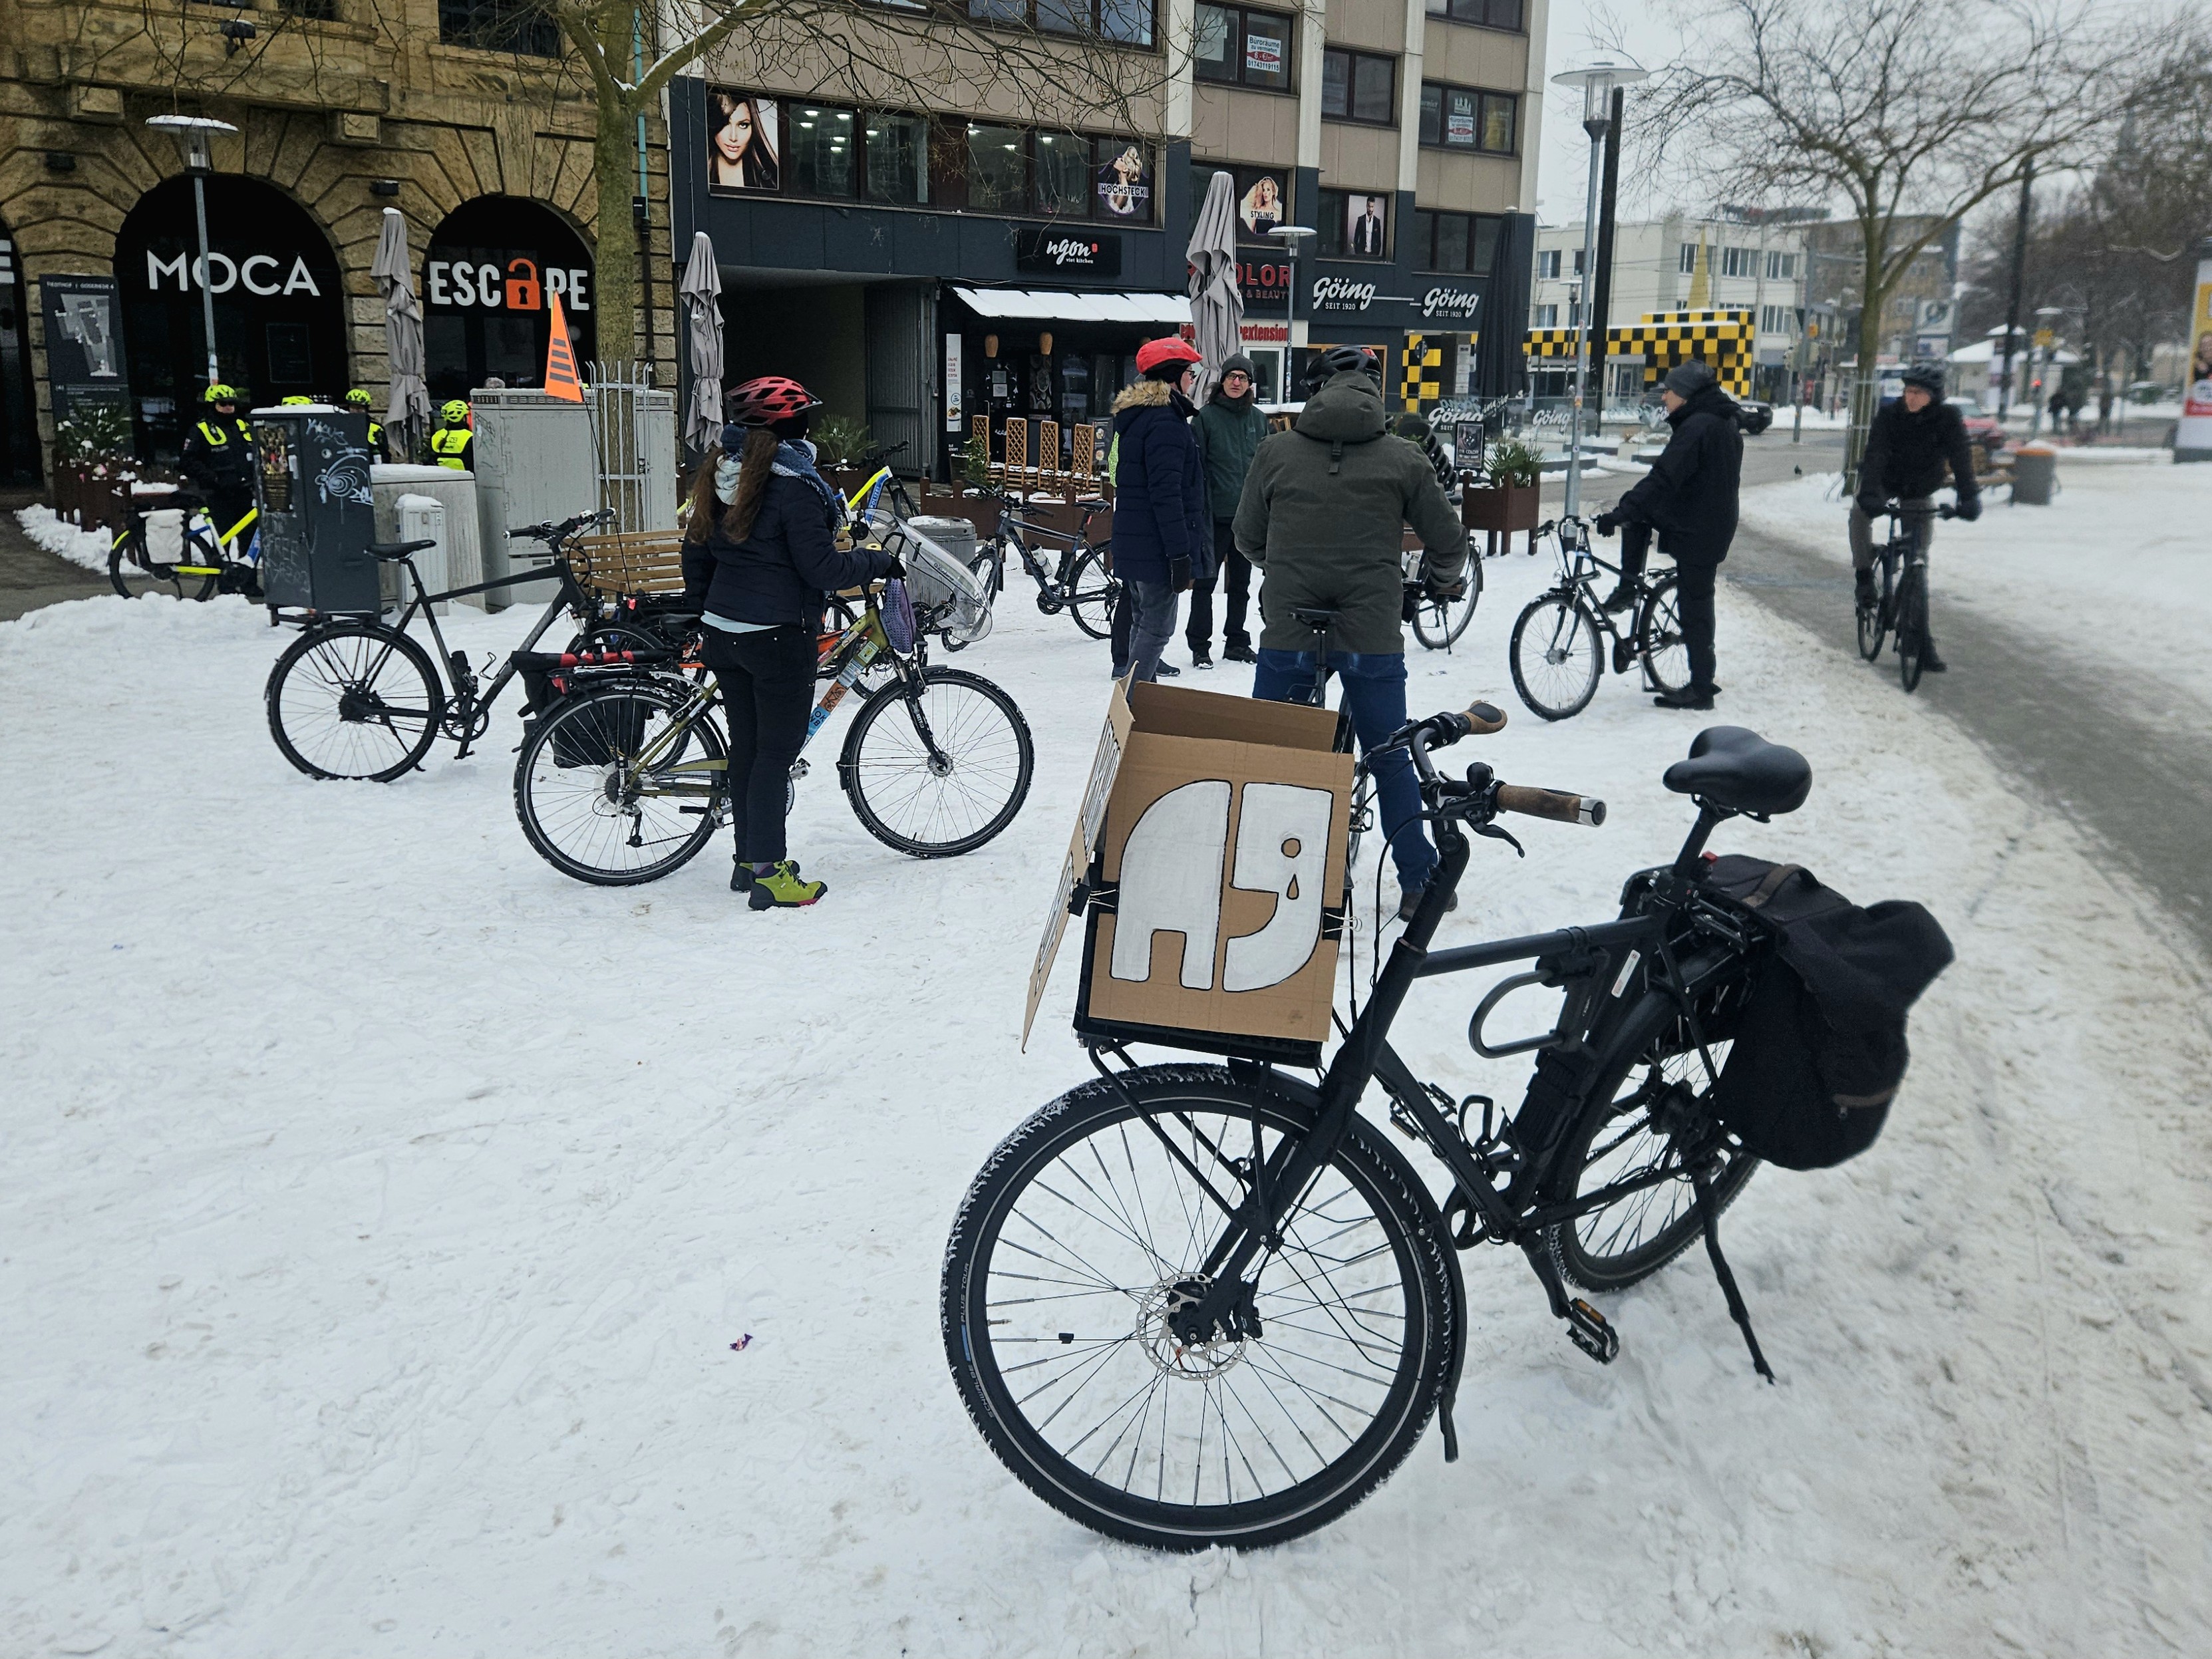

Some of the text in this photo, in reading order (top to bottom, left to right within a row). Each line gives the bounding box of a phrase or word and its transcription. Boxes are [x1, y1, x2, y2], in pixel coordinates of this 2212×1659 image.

[1249, 37, 1279, 48] Büroräume
[1101, 184, 1145, 196] HOCHSTECK
[1251, 211, 1274, 220] STYLING
[1046, 239, 1091, 265] ngon
[146, 249, 321, 297] MOCA
[1313, 277, 1376, 310] Göing
[1422, 288, 1479, 318] Göing
[1533, 409, 1571, 432] Göing
[870, 486, 879, 508] POLIZEI
[968, 1364, 995, 1418] SCHWALBE
